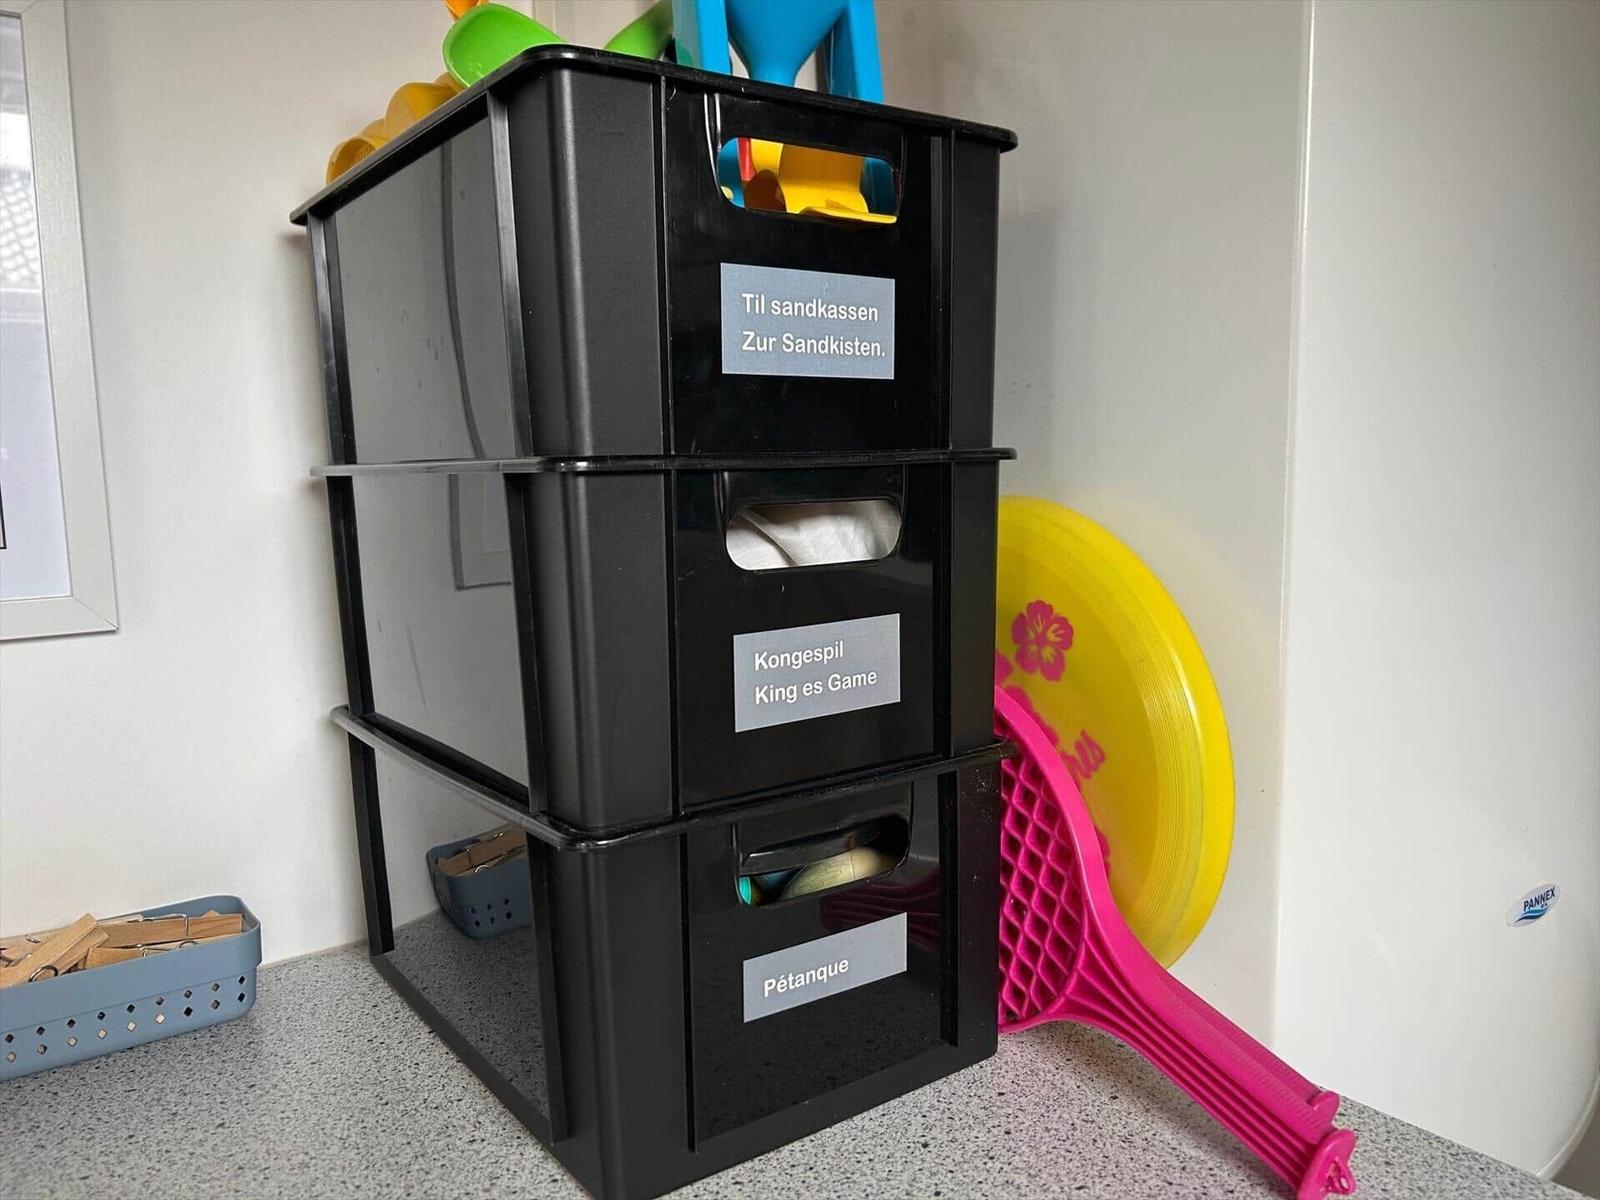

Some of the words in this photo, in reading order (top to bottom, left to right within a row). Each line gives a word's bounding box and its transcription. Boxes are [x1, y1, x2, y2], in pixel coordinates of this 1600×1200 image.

[741, 293, 765, 315] Til
[770, 298, 878, 322] sandkassen
[741, 331, 777, 352] Zur
[782, 333, 886, 357] Sandkisten.
[754, 640, 844, 671] Kongespil
[755, 684, 798, 705] King
[802, 680, 823, 696] es
[828, 671, 878, 692] Game
[1523, 886, 1556, 912] PANNEX
[763, 959, 849, 998] Pétanque
